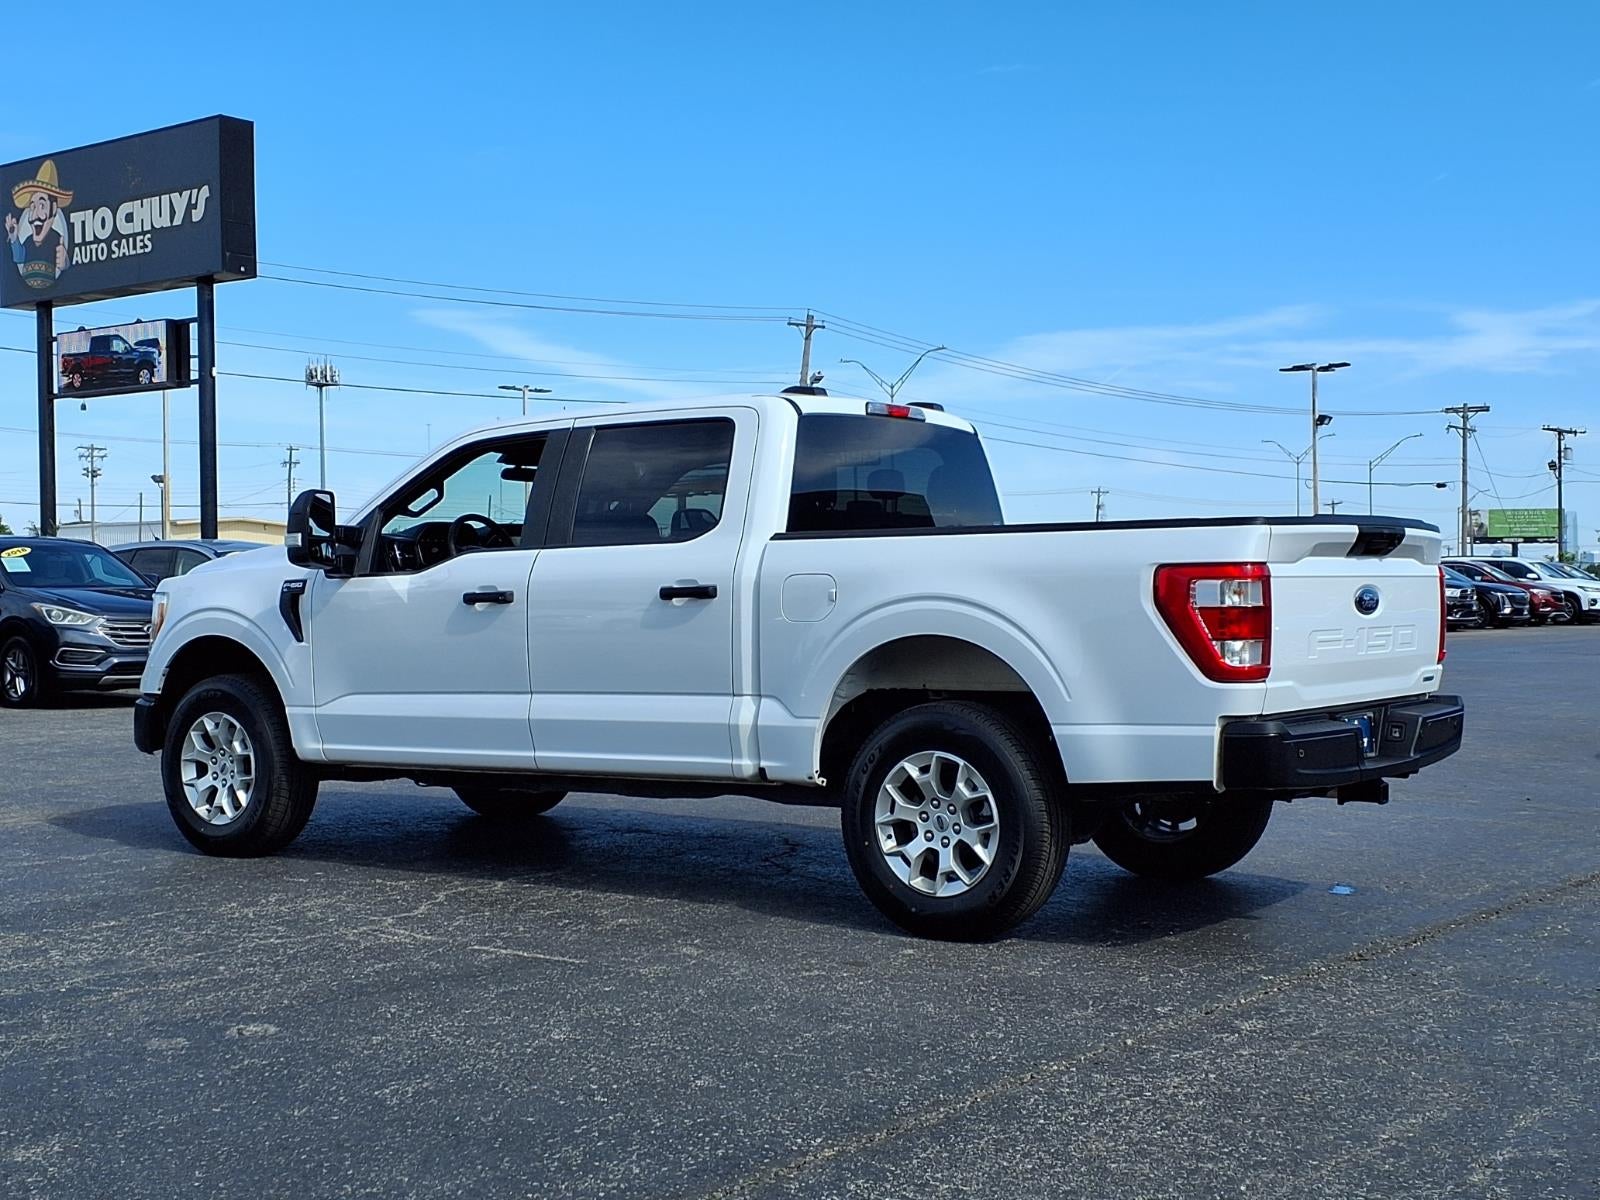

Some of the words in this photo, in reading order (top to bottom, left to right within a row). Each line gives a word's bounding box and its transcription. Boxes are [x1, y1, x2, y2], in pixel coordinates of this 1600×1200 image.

[70, 206, 114, 244] TIO
[116, 185, 210, 235] CHUY'S
[72, 243, 108, 265] AUTO
[111, 234, 153, 259] SALES
[1306, 624, 1418, 659] F-150
